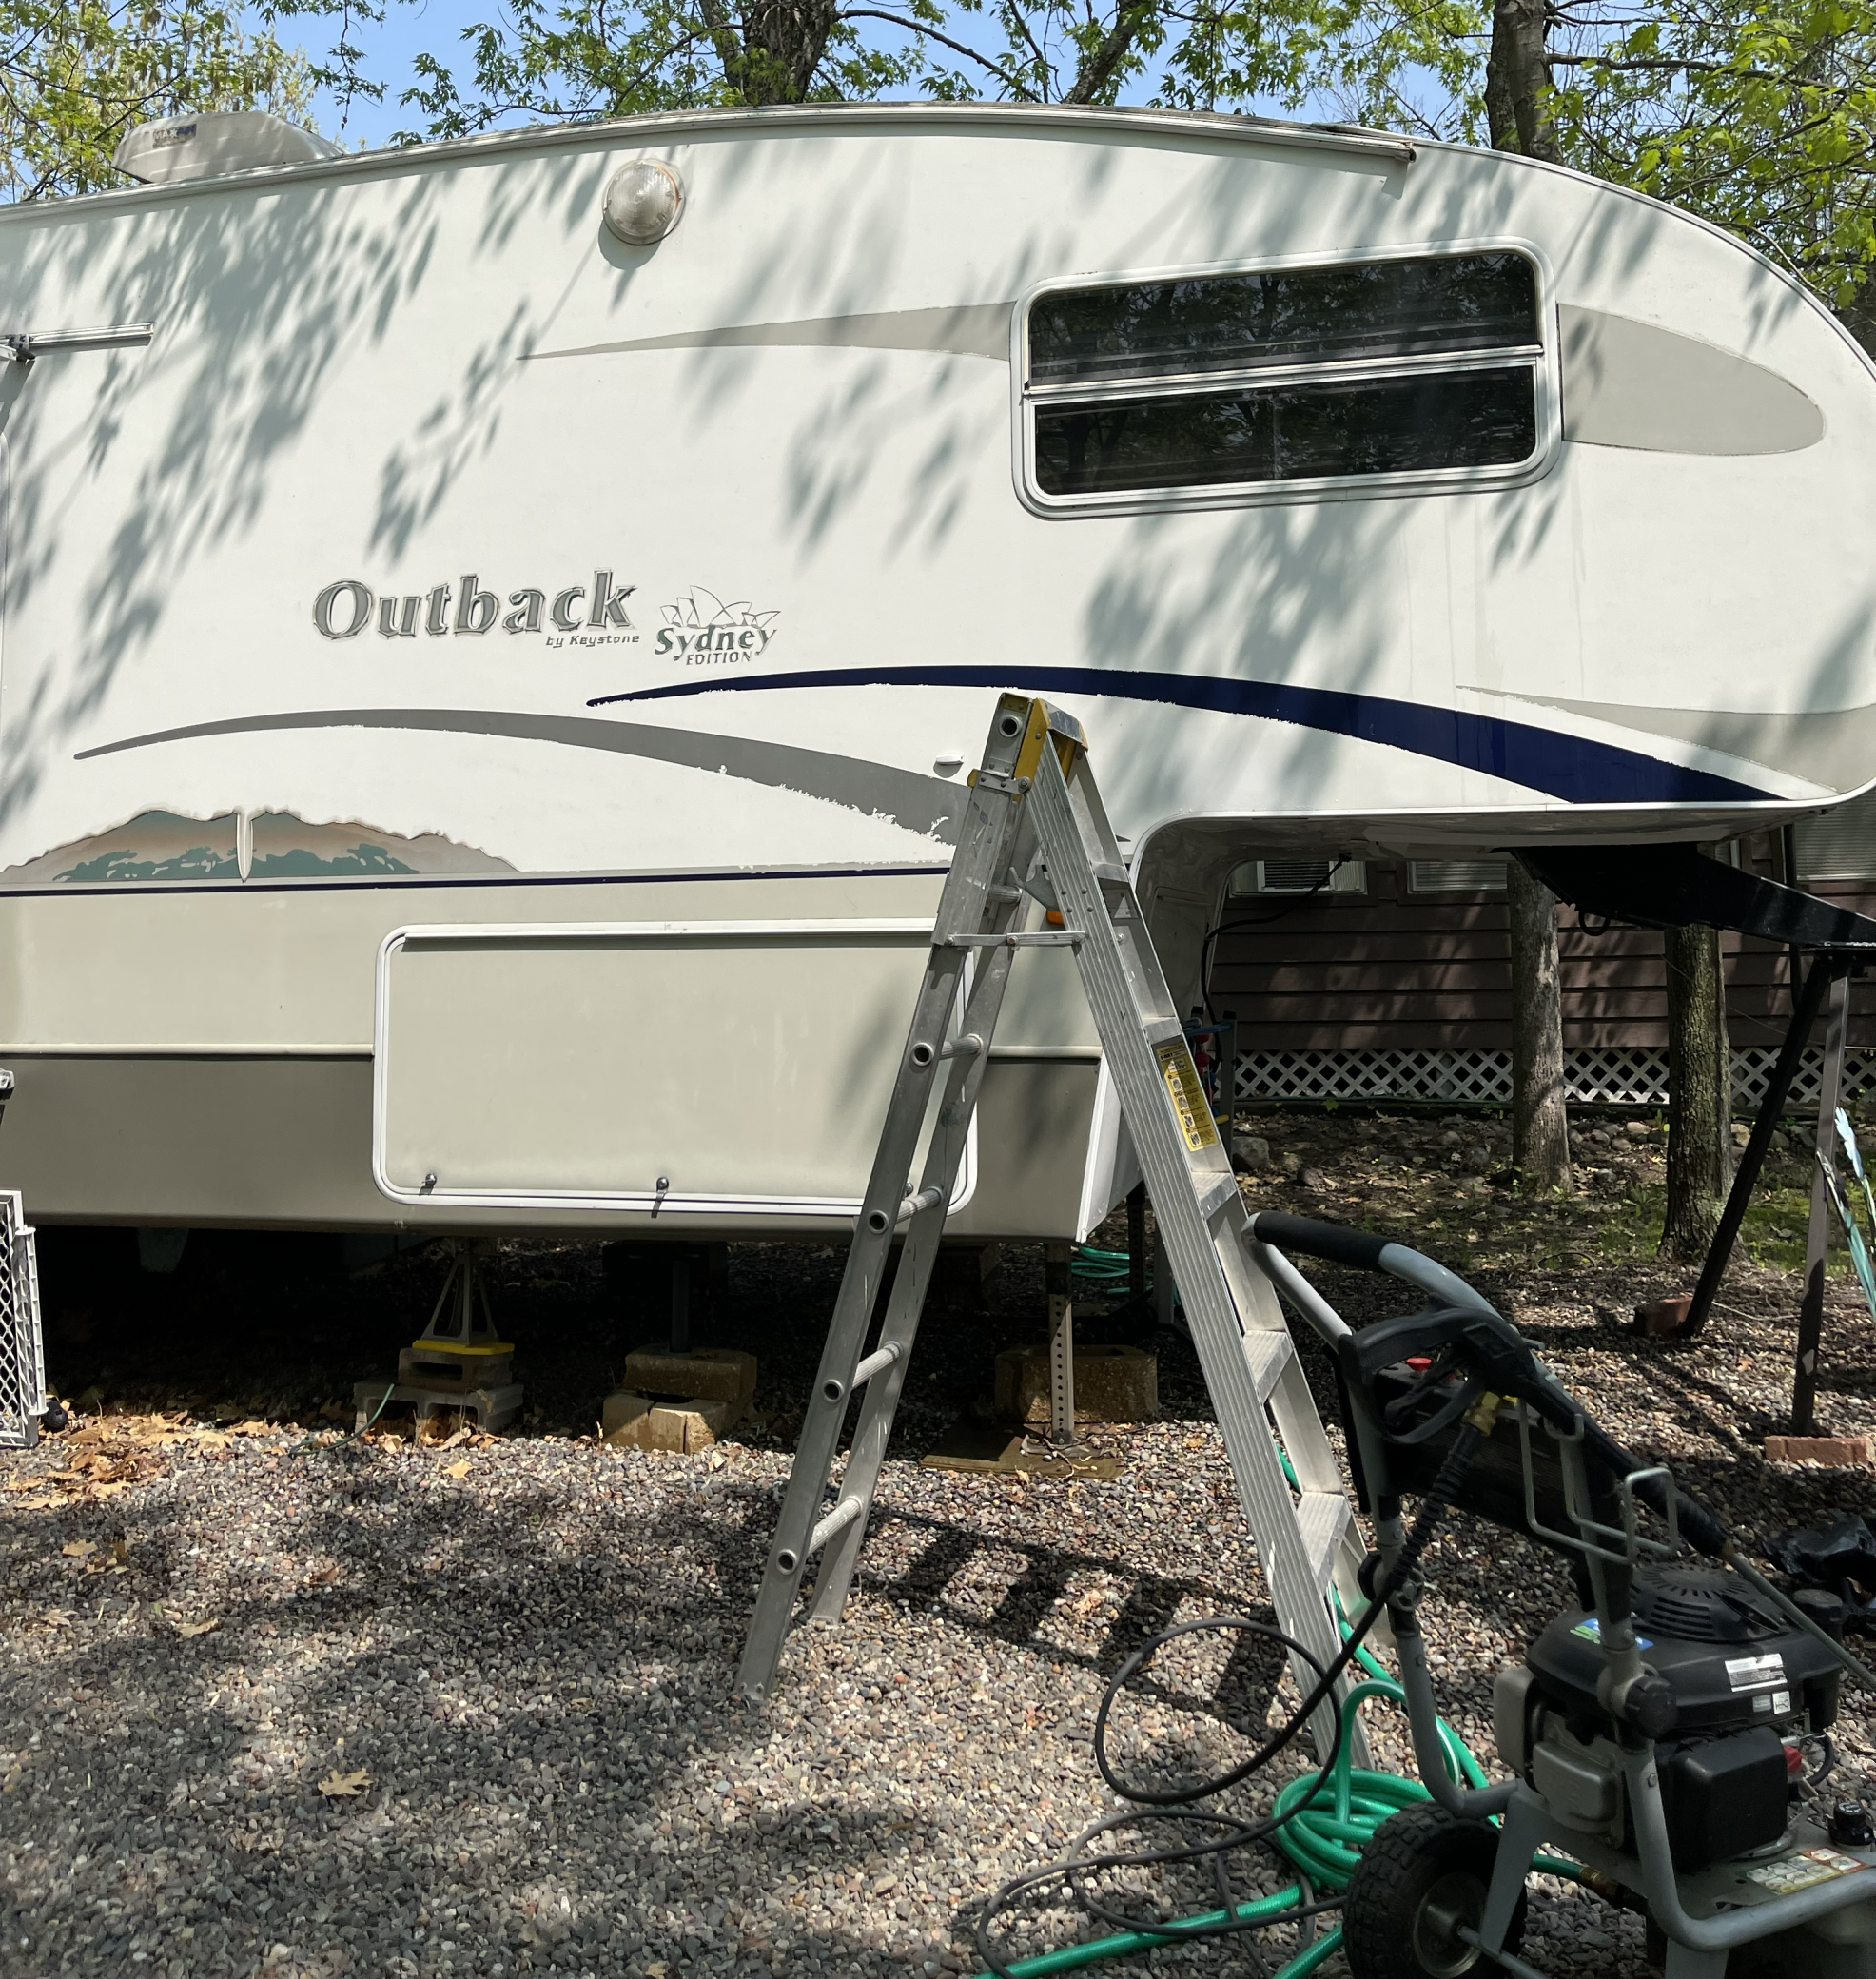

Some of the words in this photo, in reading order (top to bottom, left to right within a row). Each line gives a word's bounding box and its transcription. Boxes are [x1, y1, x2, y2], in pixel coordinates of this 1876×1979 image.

[313, 568, 638, 639] Outback
[546, 636, 565, 649] by
[569, 635, 640, 648] Keystone
[655, 626, 777, 661] Sydney
[686, 651, 752, 666] EDITION
